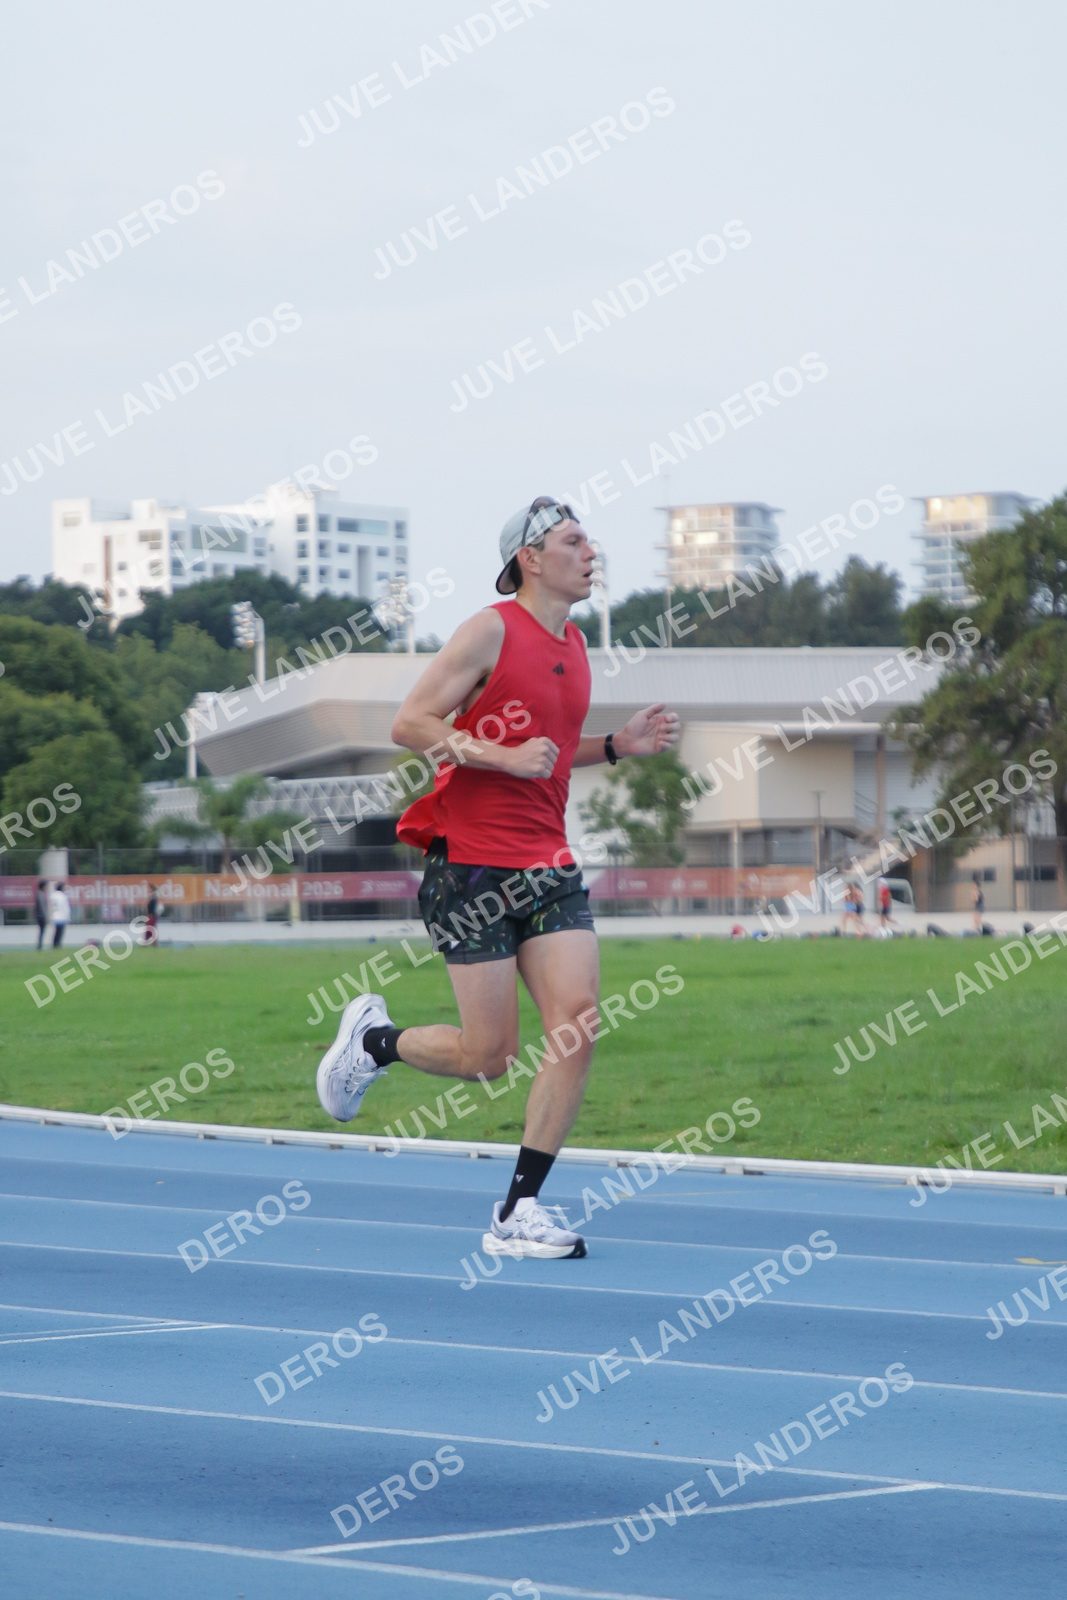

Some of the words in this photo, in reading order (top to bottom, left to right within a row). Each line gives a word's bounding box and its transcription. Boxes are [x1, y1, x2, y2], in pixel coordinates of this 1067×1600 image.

[52, 879, 185, 904] aralimpida
[204, 878, 298, 897] Naional
[303, 879, 344, 897] 2026
